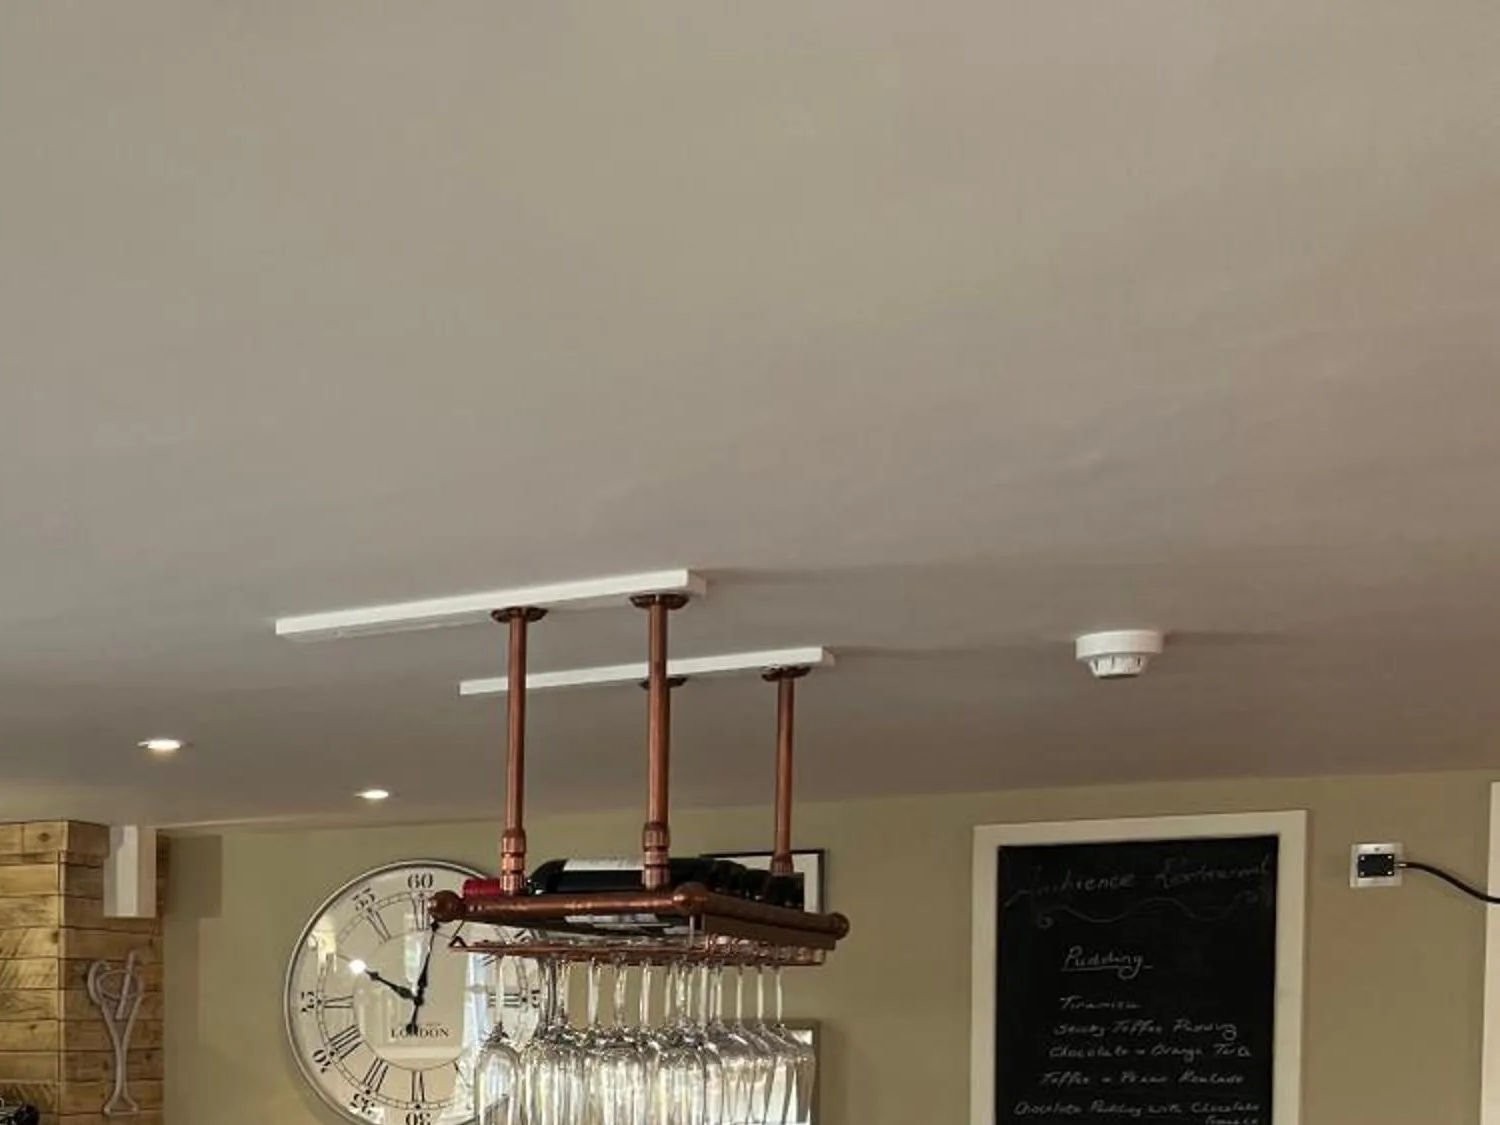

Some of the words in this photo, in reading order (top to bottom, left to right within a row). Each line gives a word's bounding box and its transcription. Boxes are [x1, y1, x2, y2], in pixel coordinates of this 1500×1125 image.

[407, 873, 433, 889] 60
[353, 887, 376, 912] 55
[300, 991, 315, 1013] 45
[313, 1047, 332, 1073] 40
